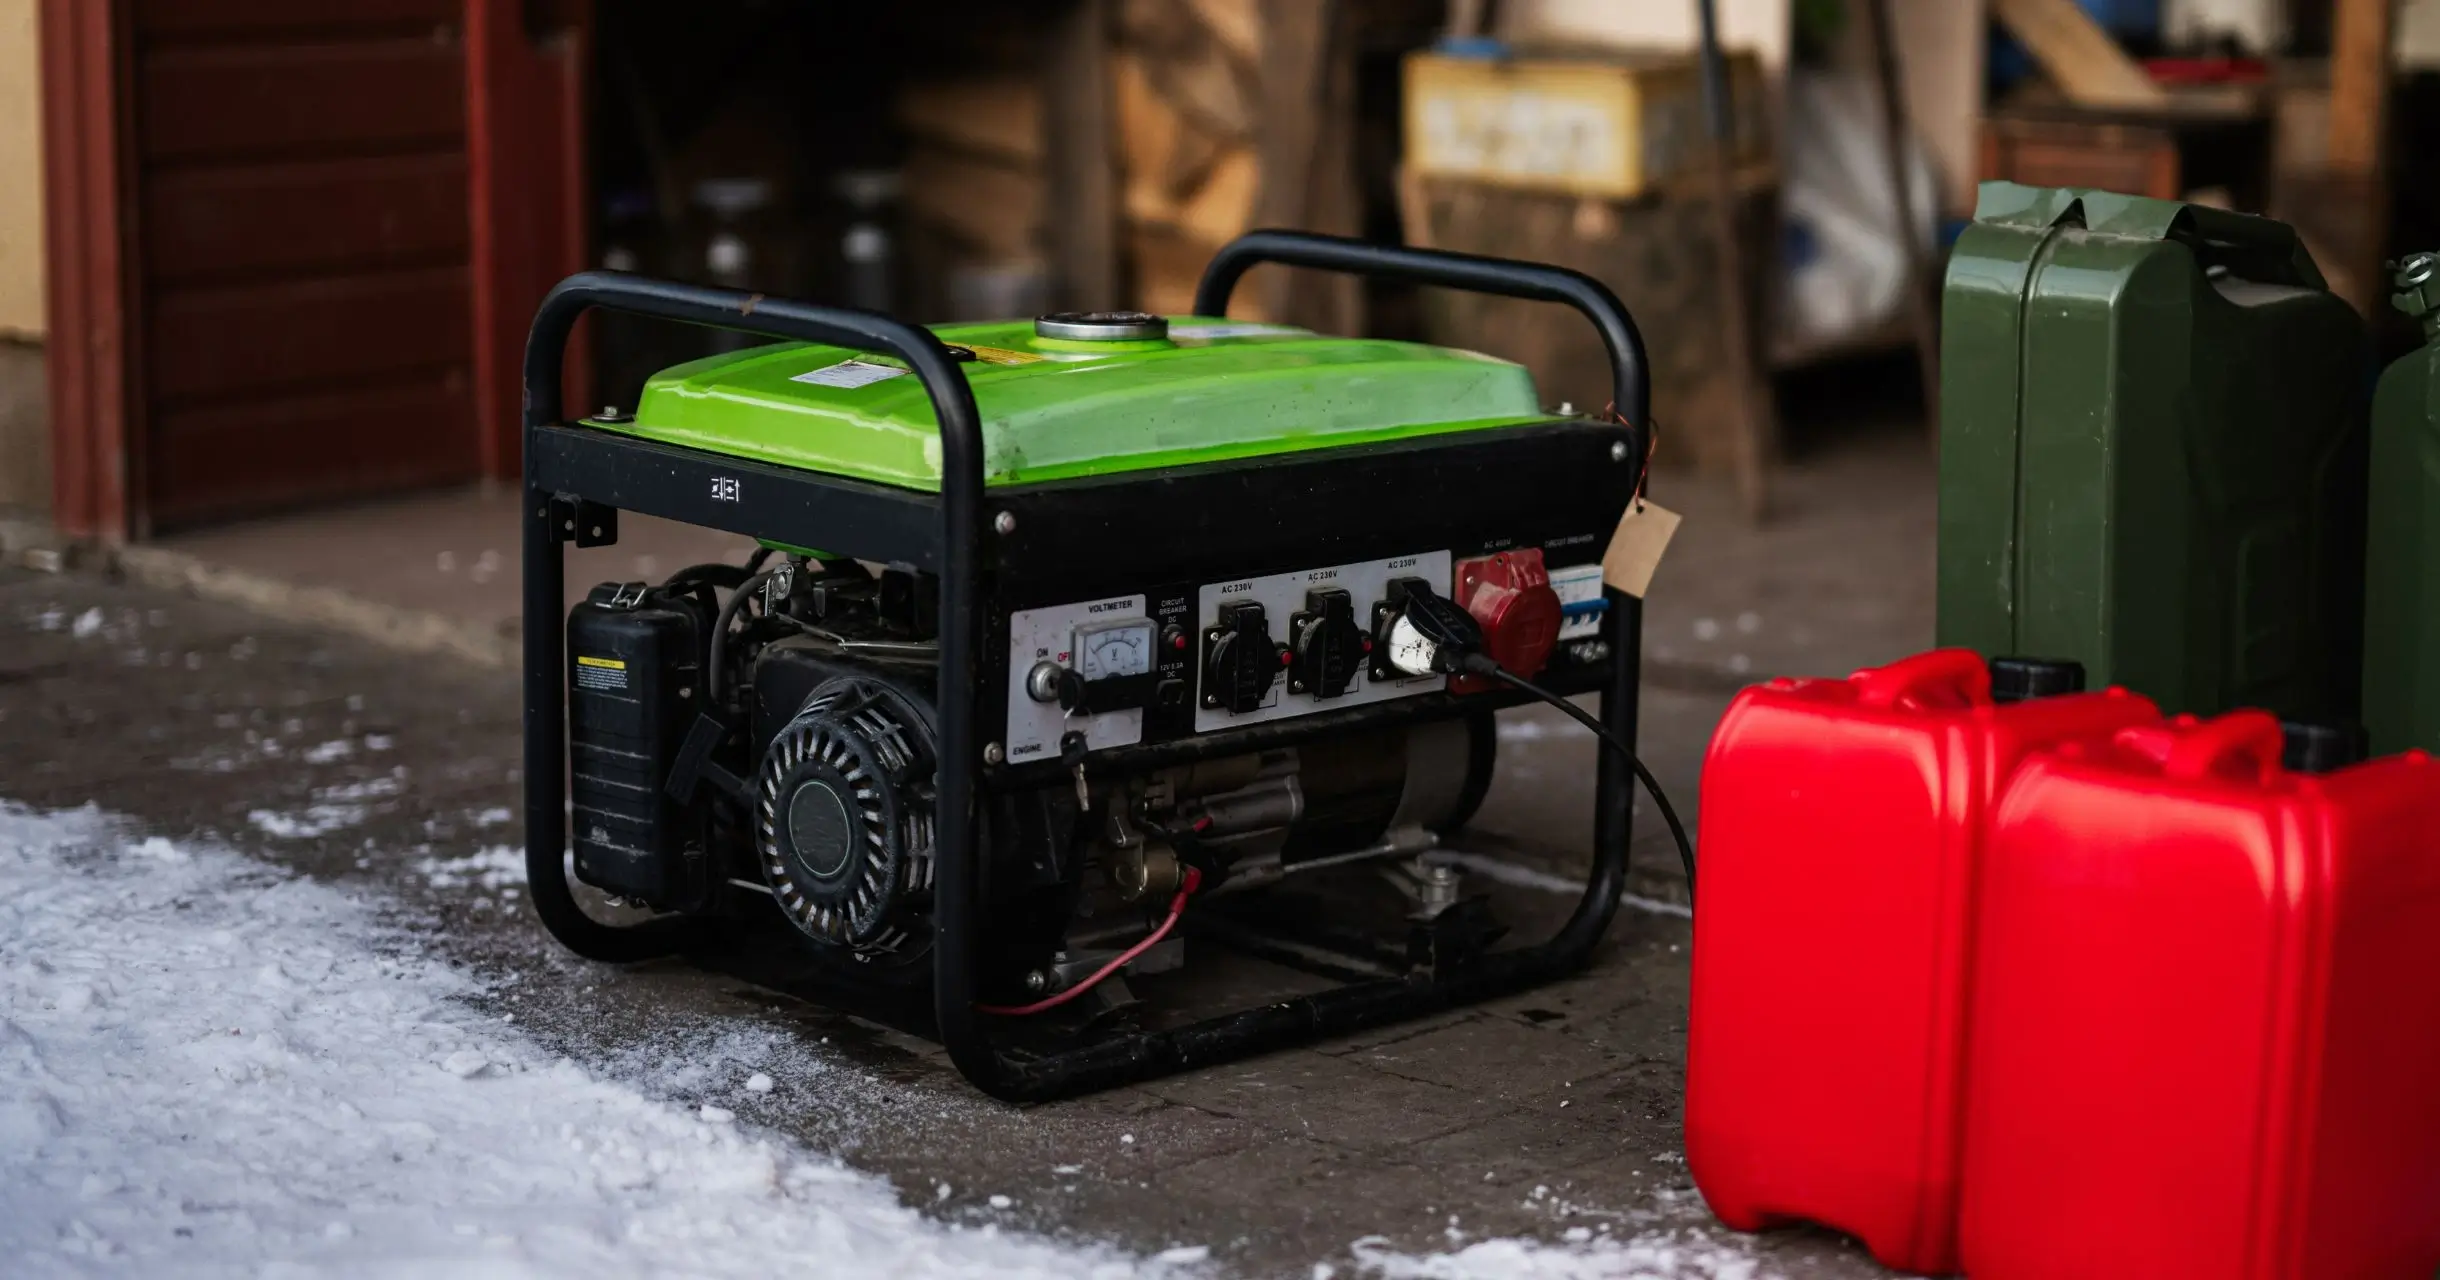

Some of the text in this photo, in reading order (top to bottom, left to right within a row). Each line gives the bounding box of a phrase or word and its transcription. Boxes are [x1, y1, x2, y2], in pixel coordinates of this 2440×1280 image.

[1388, 558, 1417, 569] AC 230V
[1308, 570, 1338, 582] AC 230V
[1221, 582, 1253, 594] AC 230V
[1088, 599, 1133, 614] VOLTMETER
[1160, 597, 1185, 607] CIRCUIT
[1158, 605, 1187, 615] BREAKER
[1036, 647, 1049, 658] ON
[1013, 743, 1042, 756] ENGINE
